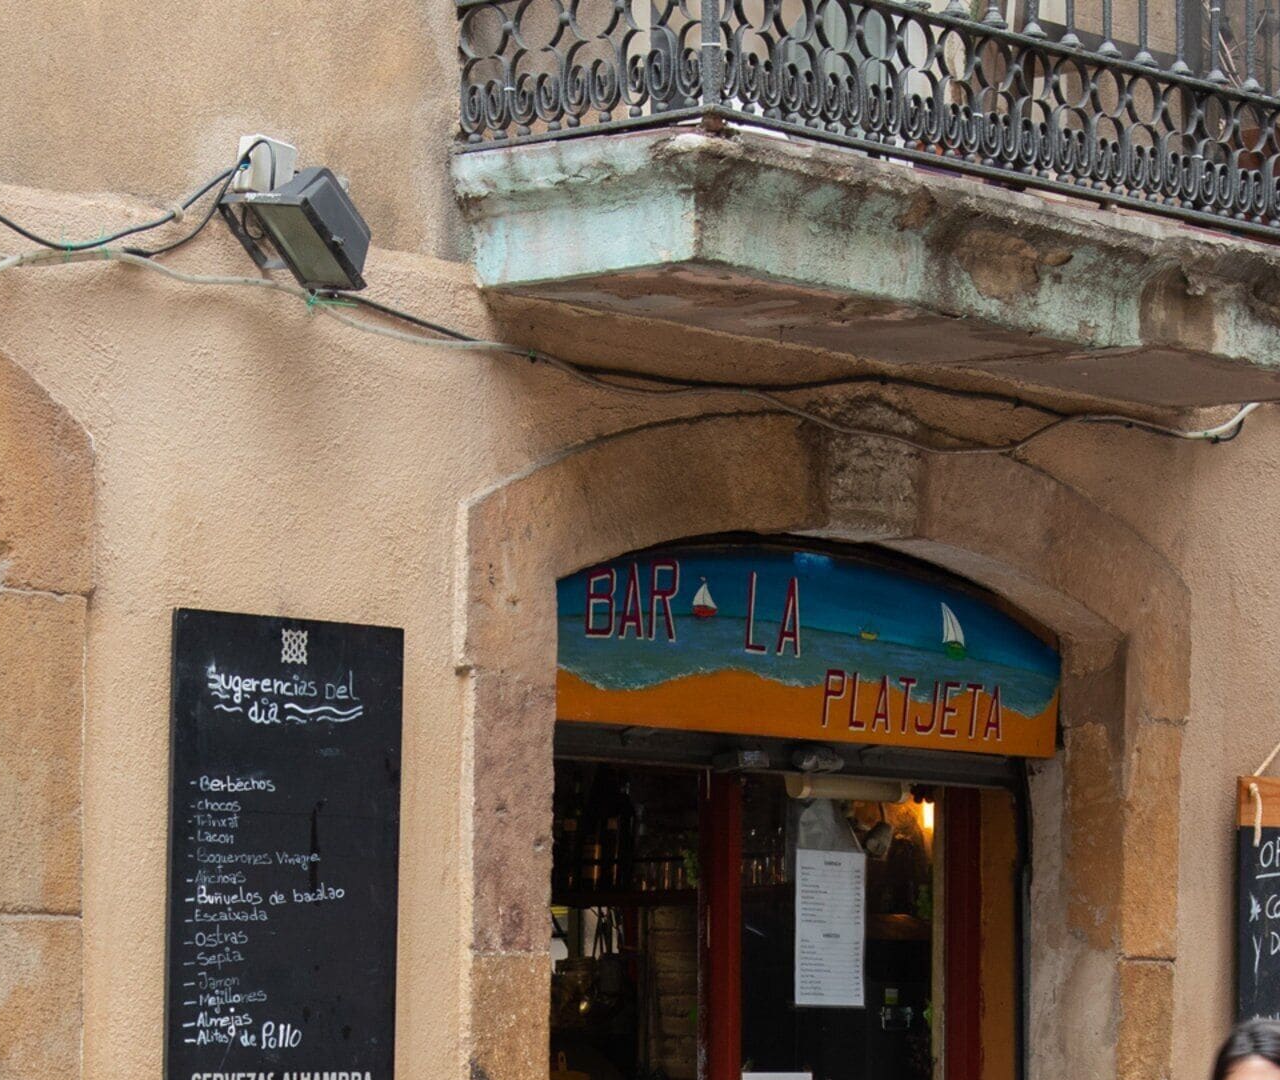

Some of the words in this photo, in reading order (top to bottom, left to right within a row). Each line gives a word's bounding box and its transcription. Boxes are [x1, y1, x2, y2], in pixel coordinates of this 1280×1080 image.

[584, 558, 679, 642] BAR
[744, 571, 801, 658] LA
[207, 666, 318, 704] Sugerencias
[821, 668, 1003, 742] PLATJETA
[270, 891, 287, 905] de
[195, 924, 248, 947] Ostras
[240, 1028, 257, 1047] de
